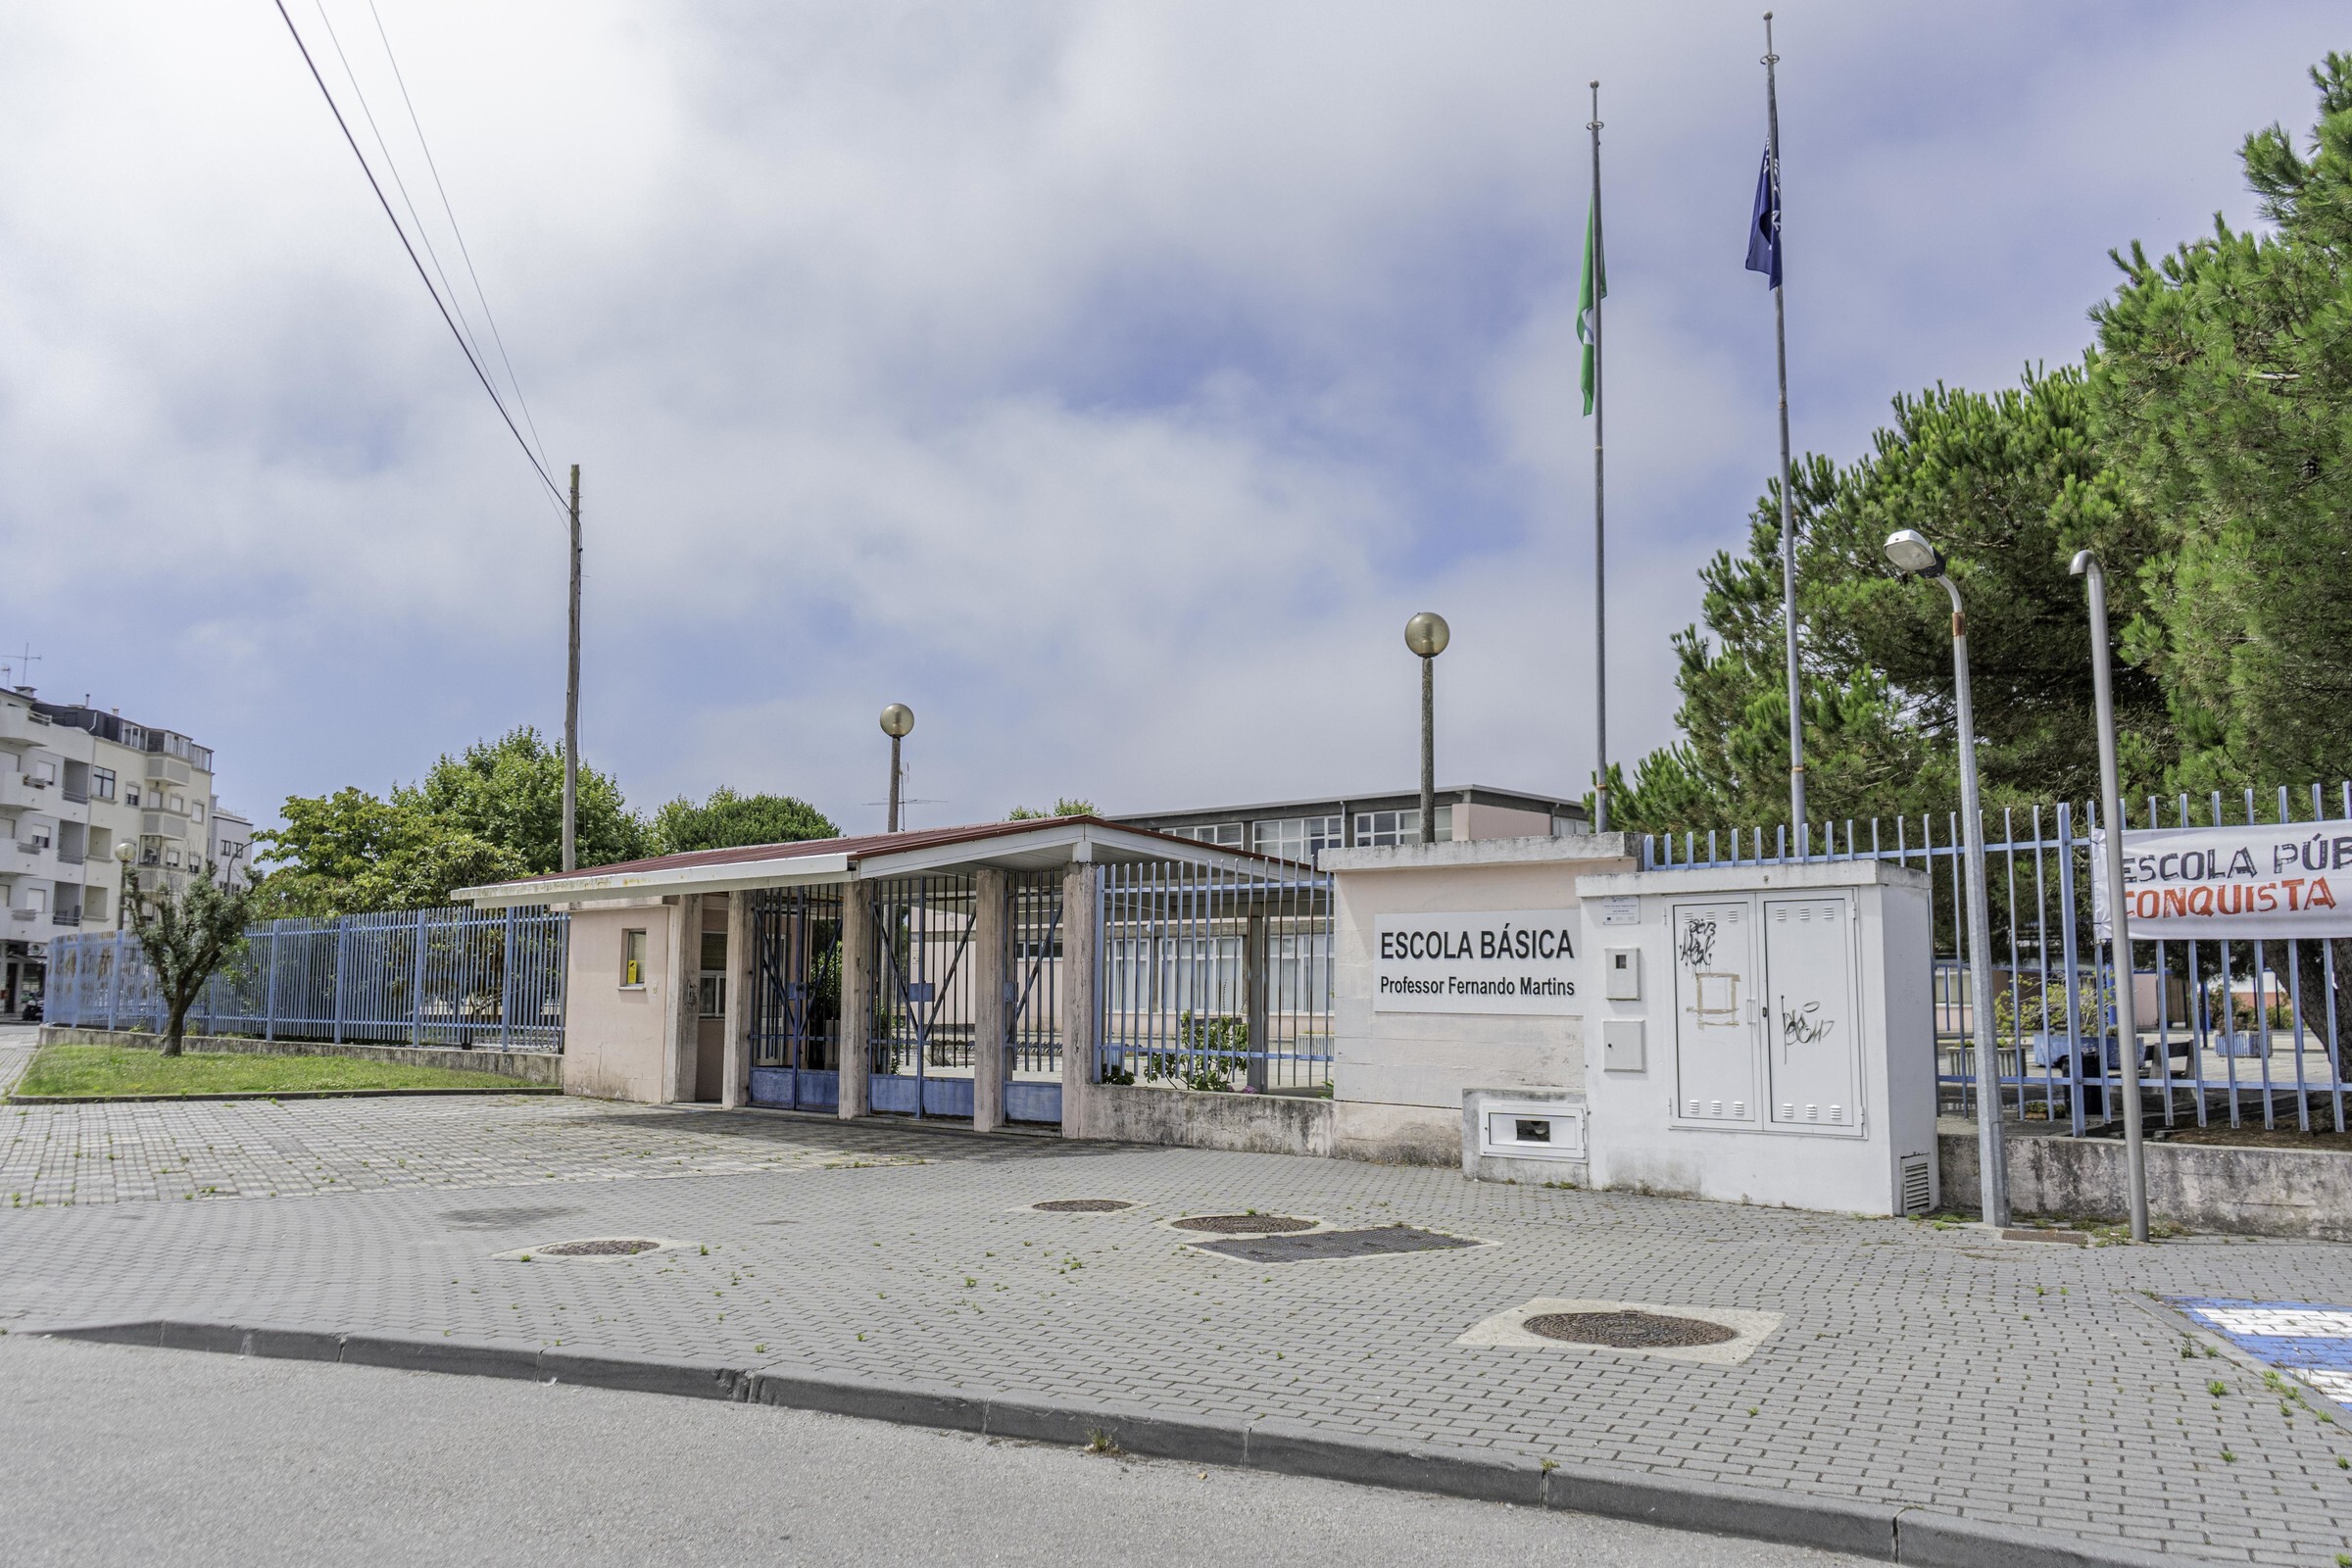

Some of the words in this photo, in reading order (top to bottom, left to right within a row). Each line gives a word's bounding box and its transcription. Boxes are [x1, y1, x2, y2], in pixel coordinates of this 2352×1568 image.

[2123, 847, 2257, 883] ESCOLA
[1381, 930, 1474, 959] ESCOLA
[1480, 922, 1575, 959] BÁSICA
[1380, 975, 1445, 995] Professor
[1448, 976, 1515, 996] Fernando
[1520, 977, 1575, 997] Martins
